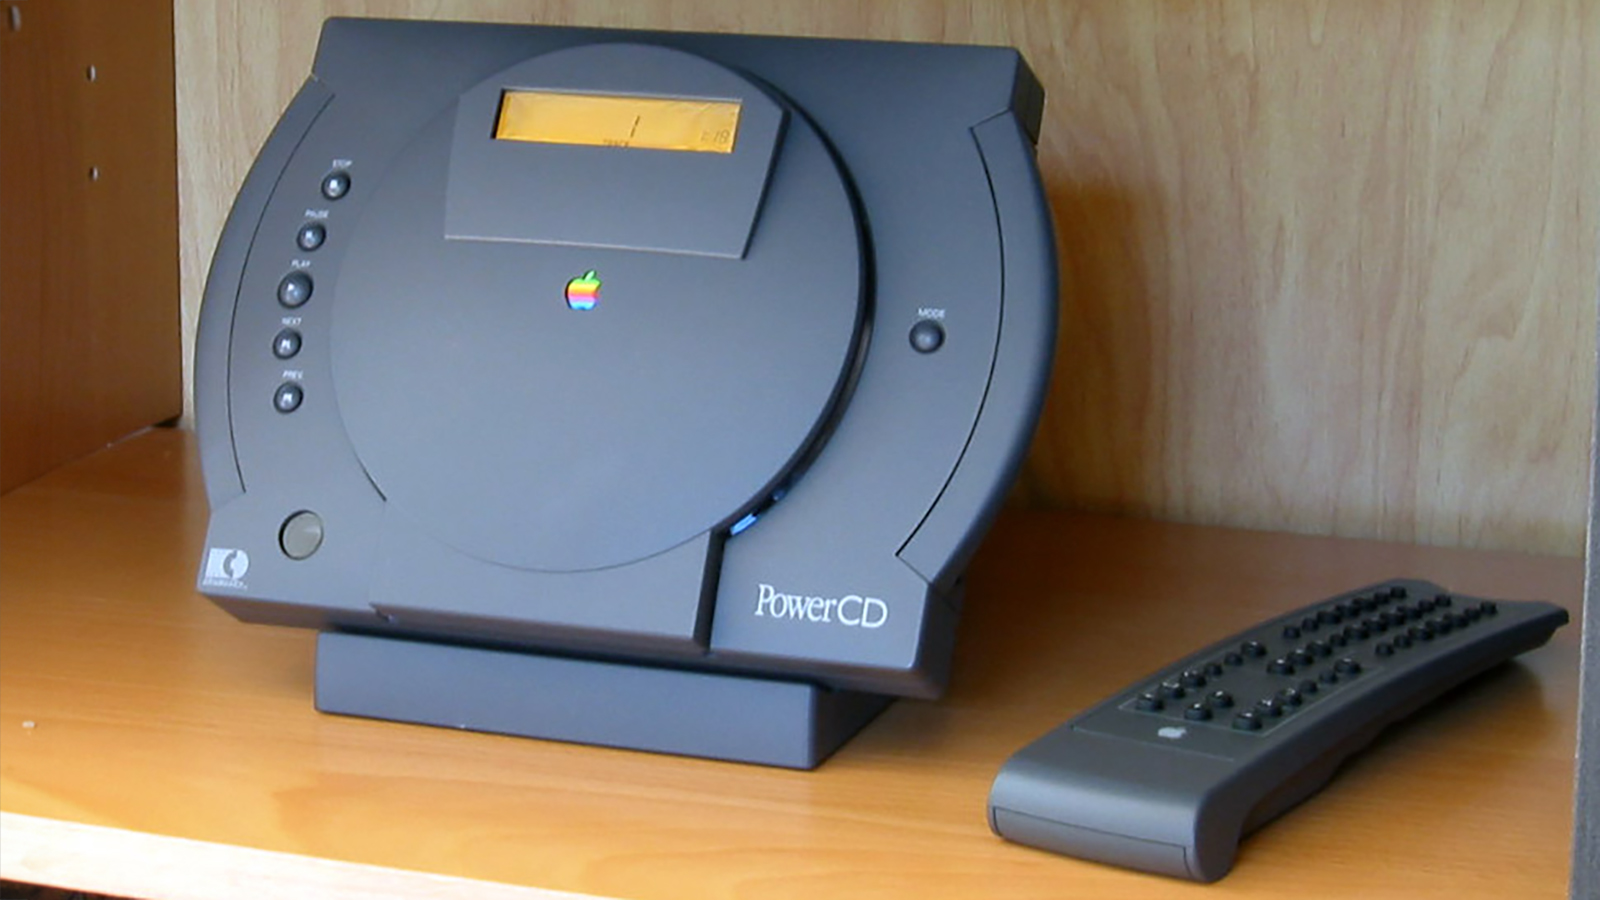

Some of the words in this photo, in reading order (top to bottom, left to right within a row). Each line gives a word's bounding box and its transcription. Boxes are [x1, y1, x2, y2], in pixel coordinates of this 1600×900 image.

[332, 158, 353, 168] STOP
[305, 208, 329, 219] PAUSE
[291, 259, 311, 269] PLAY
[918, 307, 946, 319] MODE
[282, 317, 302, 326] NEXT
